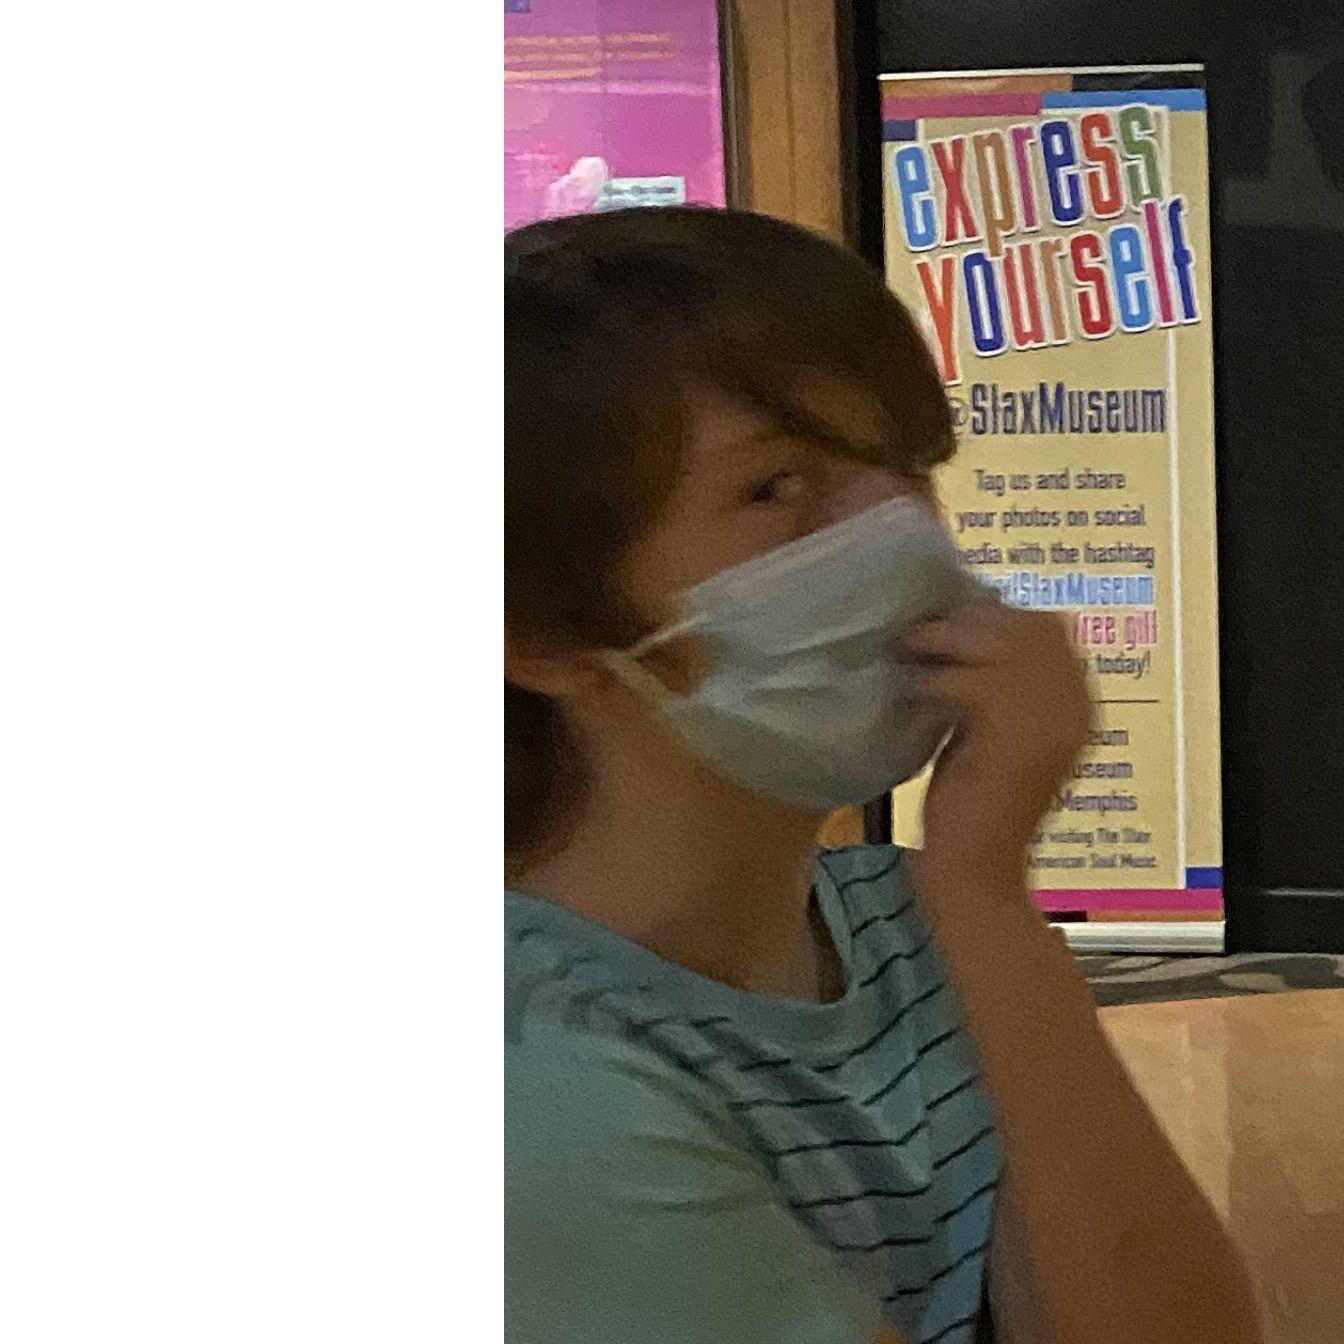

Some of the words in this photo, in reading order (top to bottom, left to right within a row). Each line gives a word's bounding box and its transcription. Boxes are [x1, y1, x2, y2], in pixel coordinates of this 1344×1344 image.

[895, 106, 1163, 258] express
[916, 198, 1198, 382] yourself
[974, 468, 1005, 496] Tag
[1010, 474, 1031, 490] us
[1036, 467, 1069, 489] and
[1075, 468, 1127, 490] share
[958, 510, 997, 532] your
[1003, 507, 1060, 533] photos
[1067, 509, 1089, 527] on
[1095, 504, 1146, 527] social
[1007, 542, 1045, 564] with
[1050, 542, 1080, 564] the
[1084, 541, 1155, 568] hashtag
